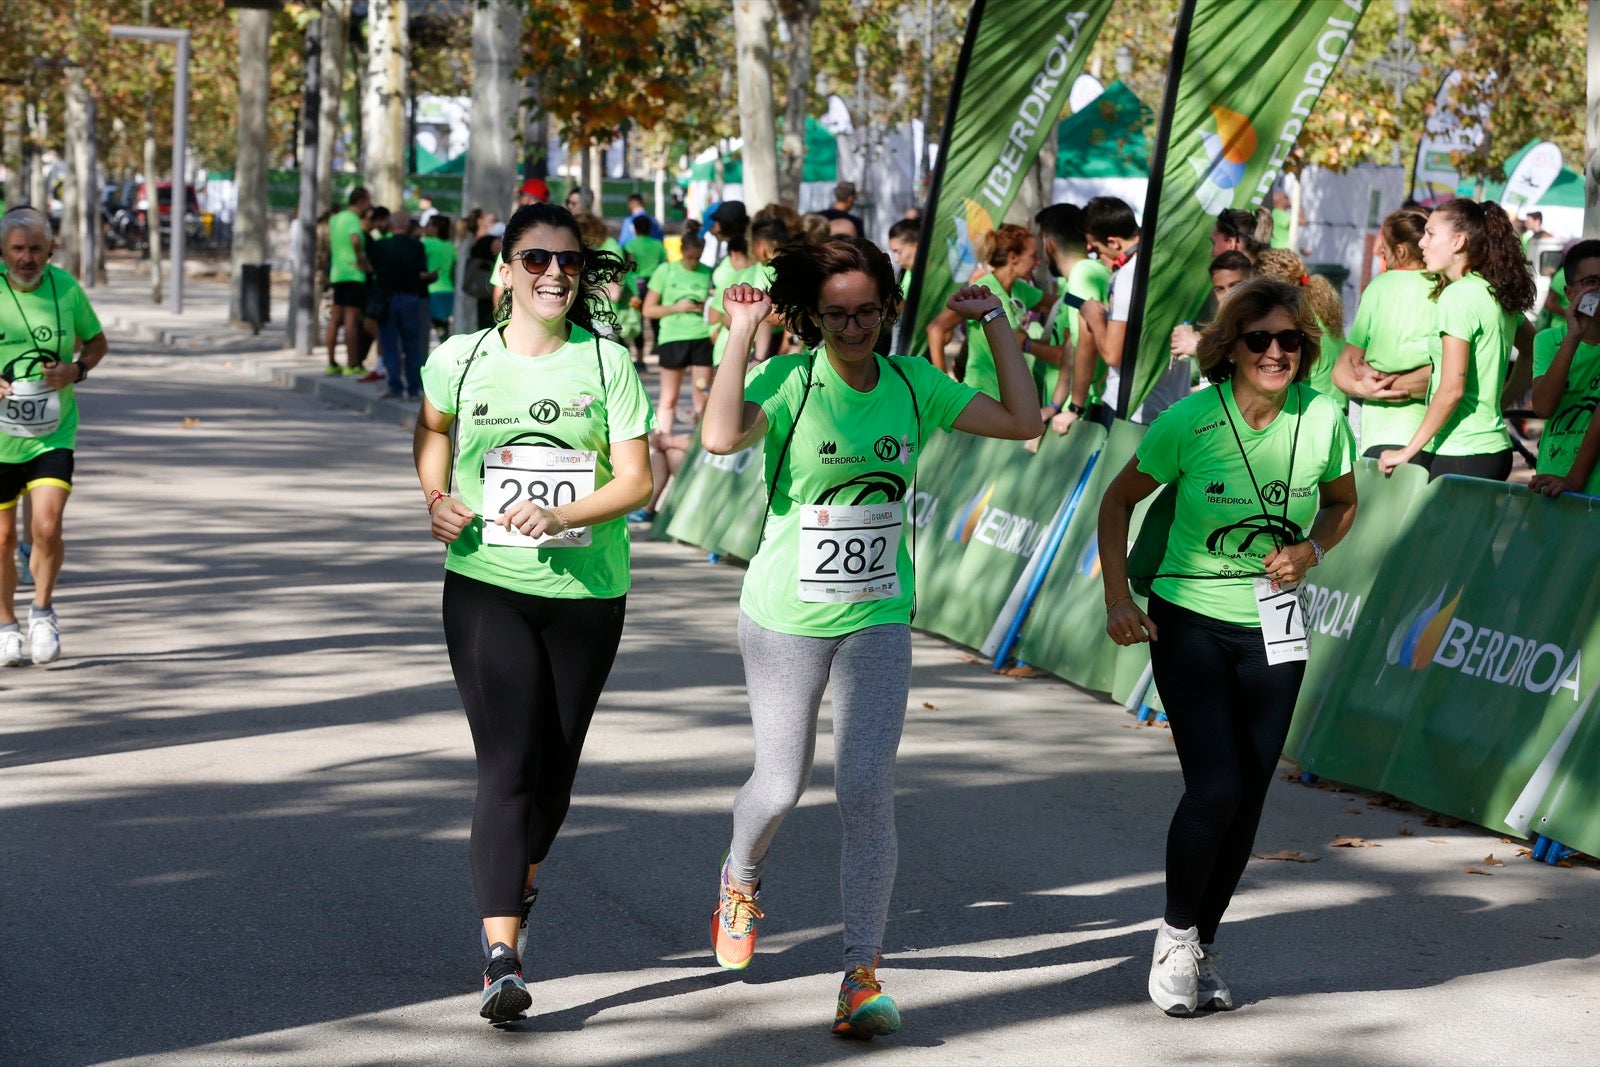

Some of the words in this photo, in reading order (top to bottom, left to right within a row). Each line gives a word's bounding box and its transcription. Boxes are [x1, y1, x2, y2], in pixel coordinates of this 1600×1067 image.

[982, 11, 1089, 207] IBERDROLA
[6, 398, 49, 420] 597
[474, 417, 520, 426] IBERDROLA
[1194, 421, 1219, 435] luanvi
[821, 456, 867, 465] IBERDROLA
[499, 478, 576, 514] 280
[1207, 496, 1253, 505] IBERDROLA
[1291, 490, 1312, 498] MUJER
[815, 536, 887, 575] 282
